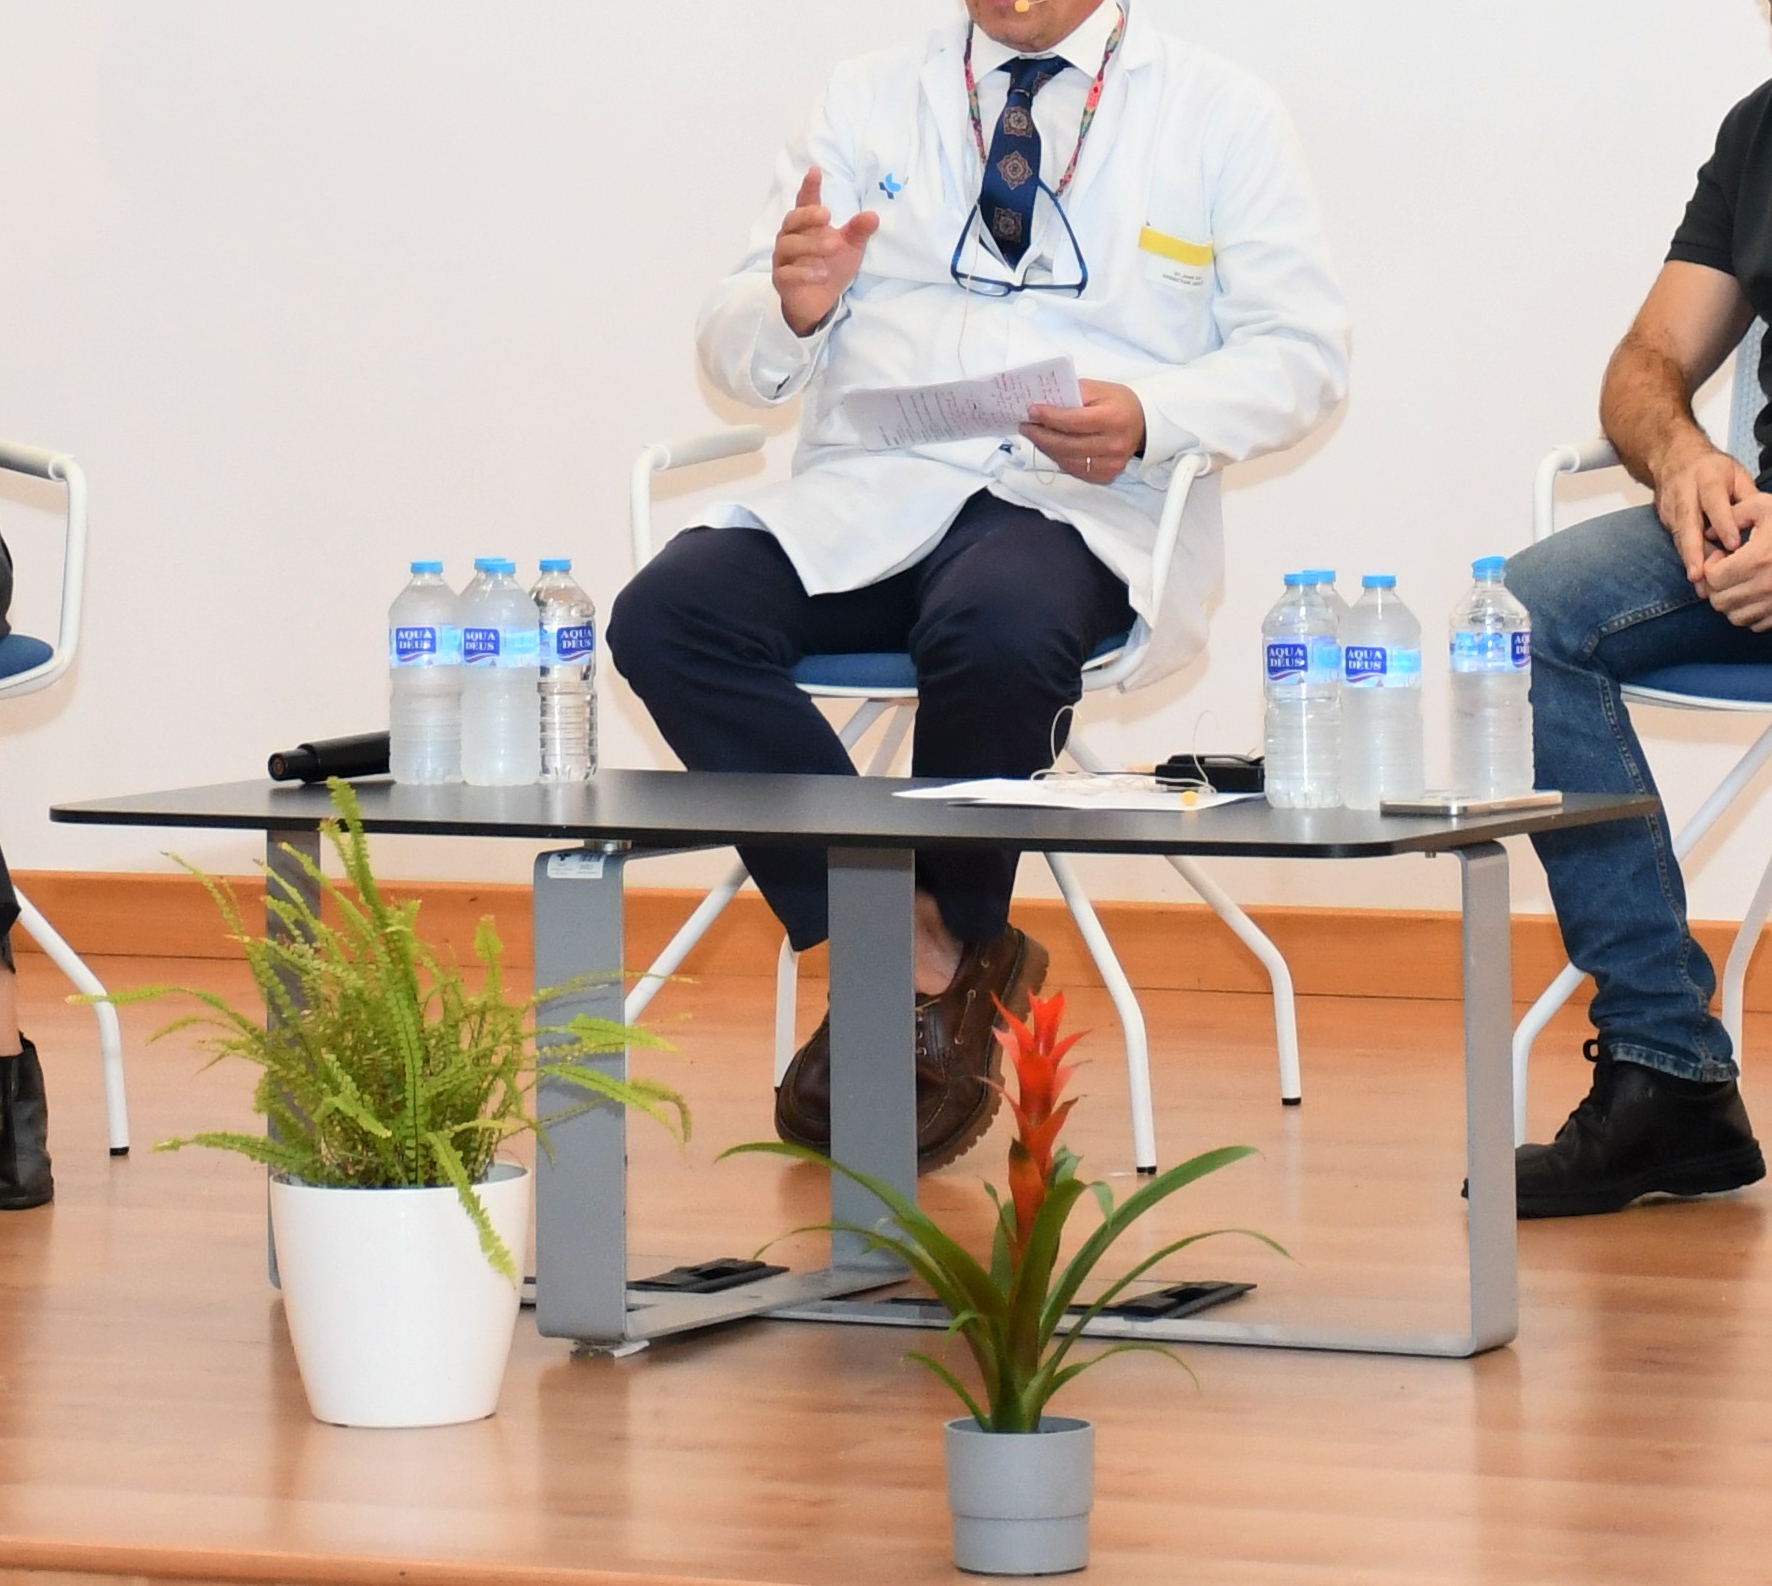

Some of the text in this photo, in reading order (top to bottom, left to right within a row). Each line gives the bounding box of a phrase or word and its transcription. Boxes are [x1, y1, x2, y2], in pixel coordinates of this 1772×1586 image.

[397, 628, 432, 640] AQUA
[465, 632, 496, 642] AQUA
[560, 628, 592, 640] AQUA
[398, 641, 432, 650] DEUS
[465, 642, 495, 651] DEUS
[562, 640, 592, 650] DEUS
[1269, 647, 1304, 657] AQUA
[1347, 649, 1382, 660] AQUA
[1270, 658, 1304, 667] DEUS
[1348, 660, 1382, 670] DEUS
